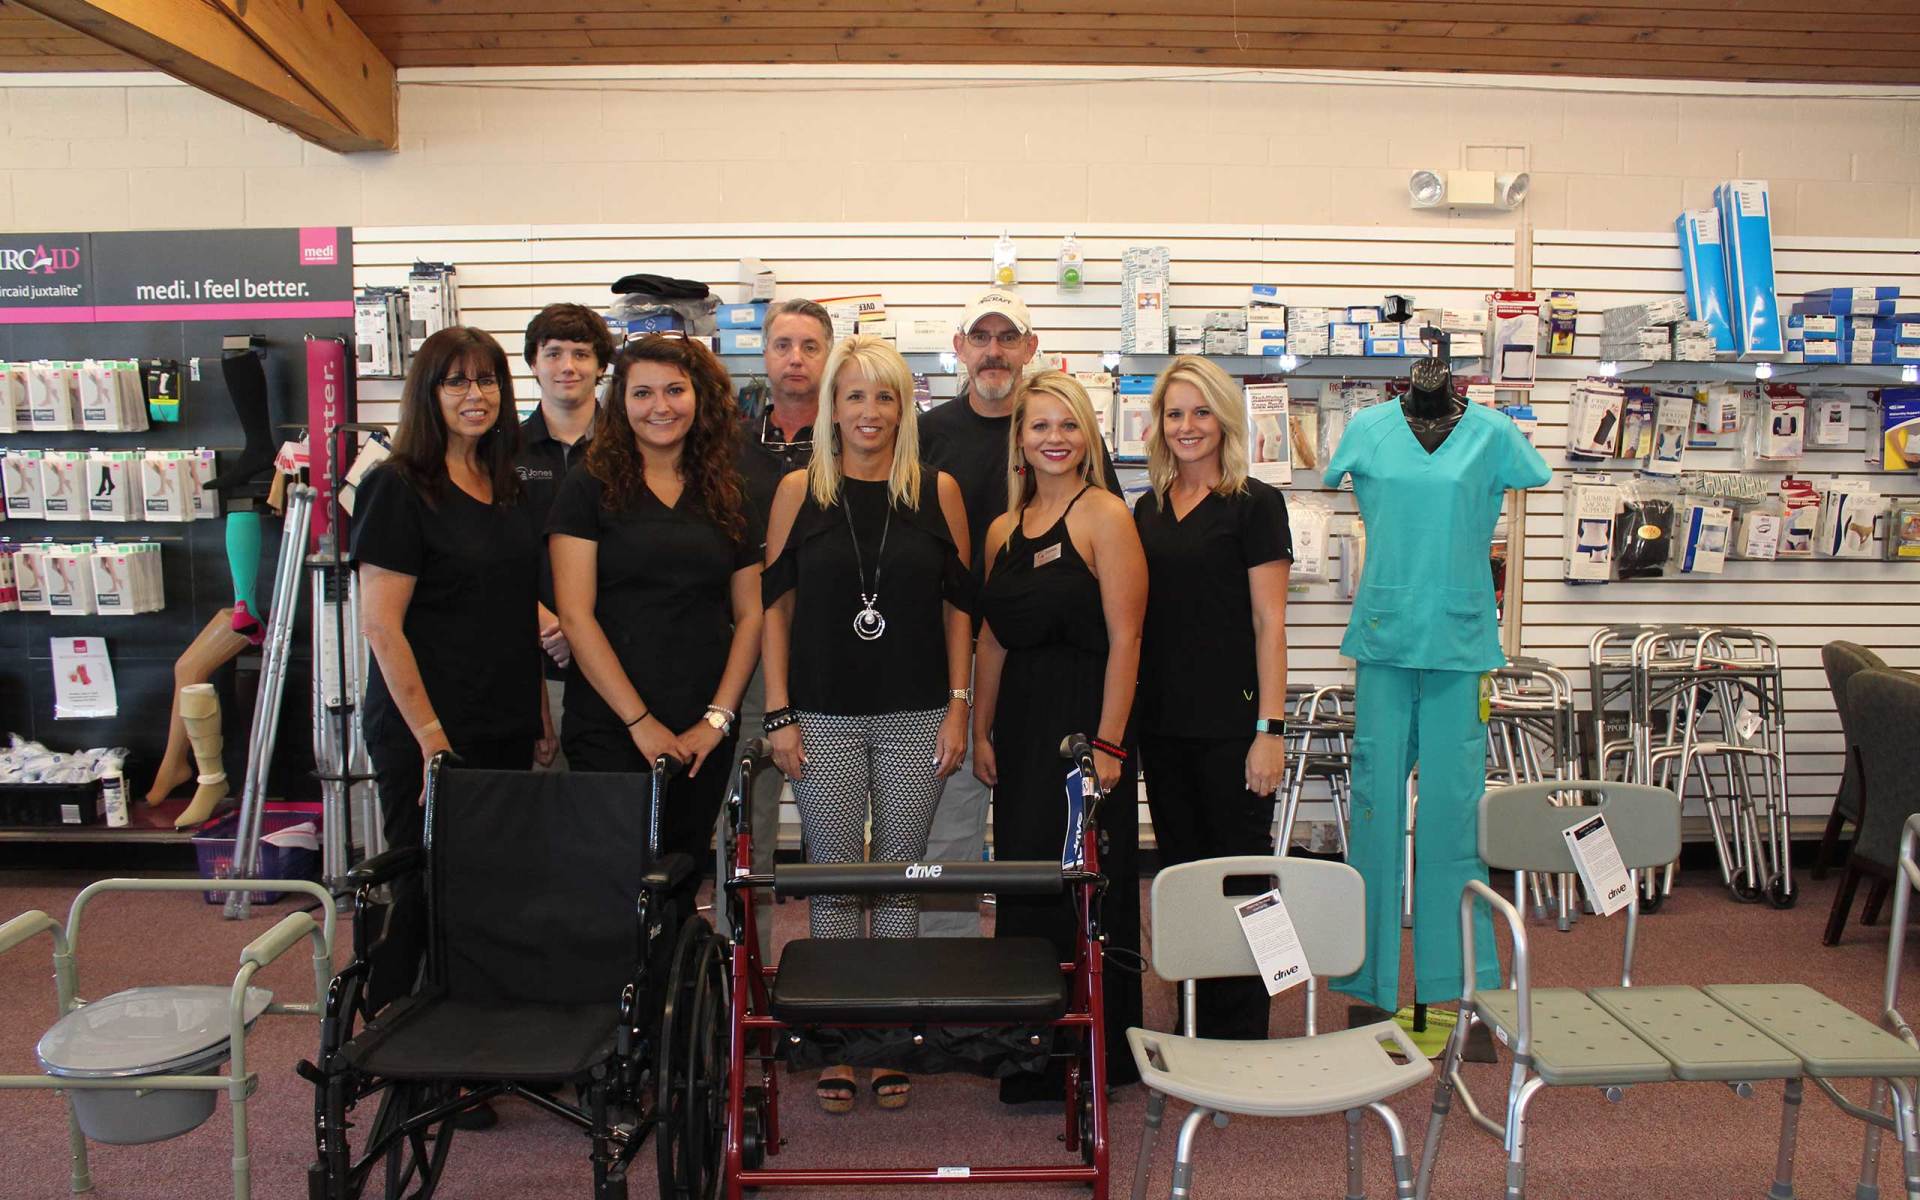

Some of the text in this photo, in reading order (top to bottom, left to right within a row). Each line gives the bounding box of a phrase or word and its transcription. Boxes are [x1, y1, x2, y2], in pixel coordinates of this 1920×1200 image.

[0, 244, 81, 274] IRCAID
[304, 245, 334, 258] medi
[0, 285, 29, 297] ircaid
[136, 279, 309, 299] medi. I feel better.
[905, 863, 943, 879] drive
[1607, 884, 1627, 900] drive
[1273, 965, 1299, 981] drive
